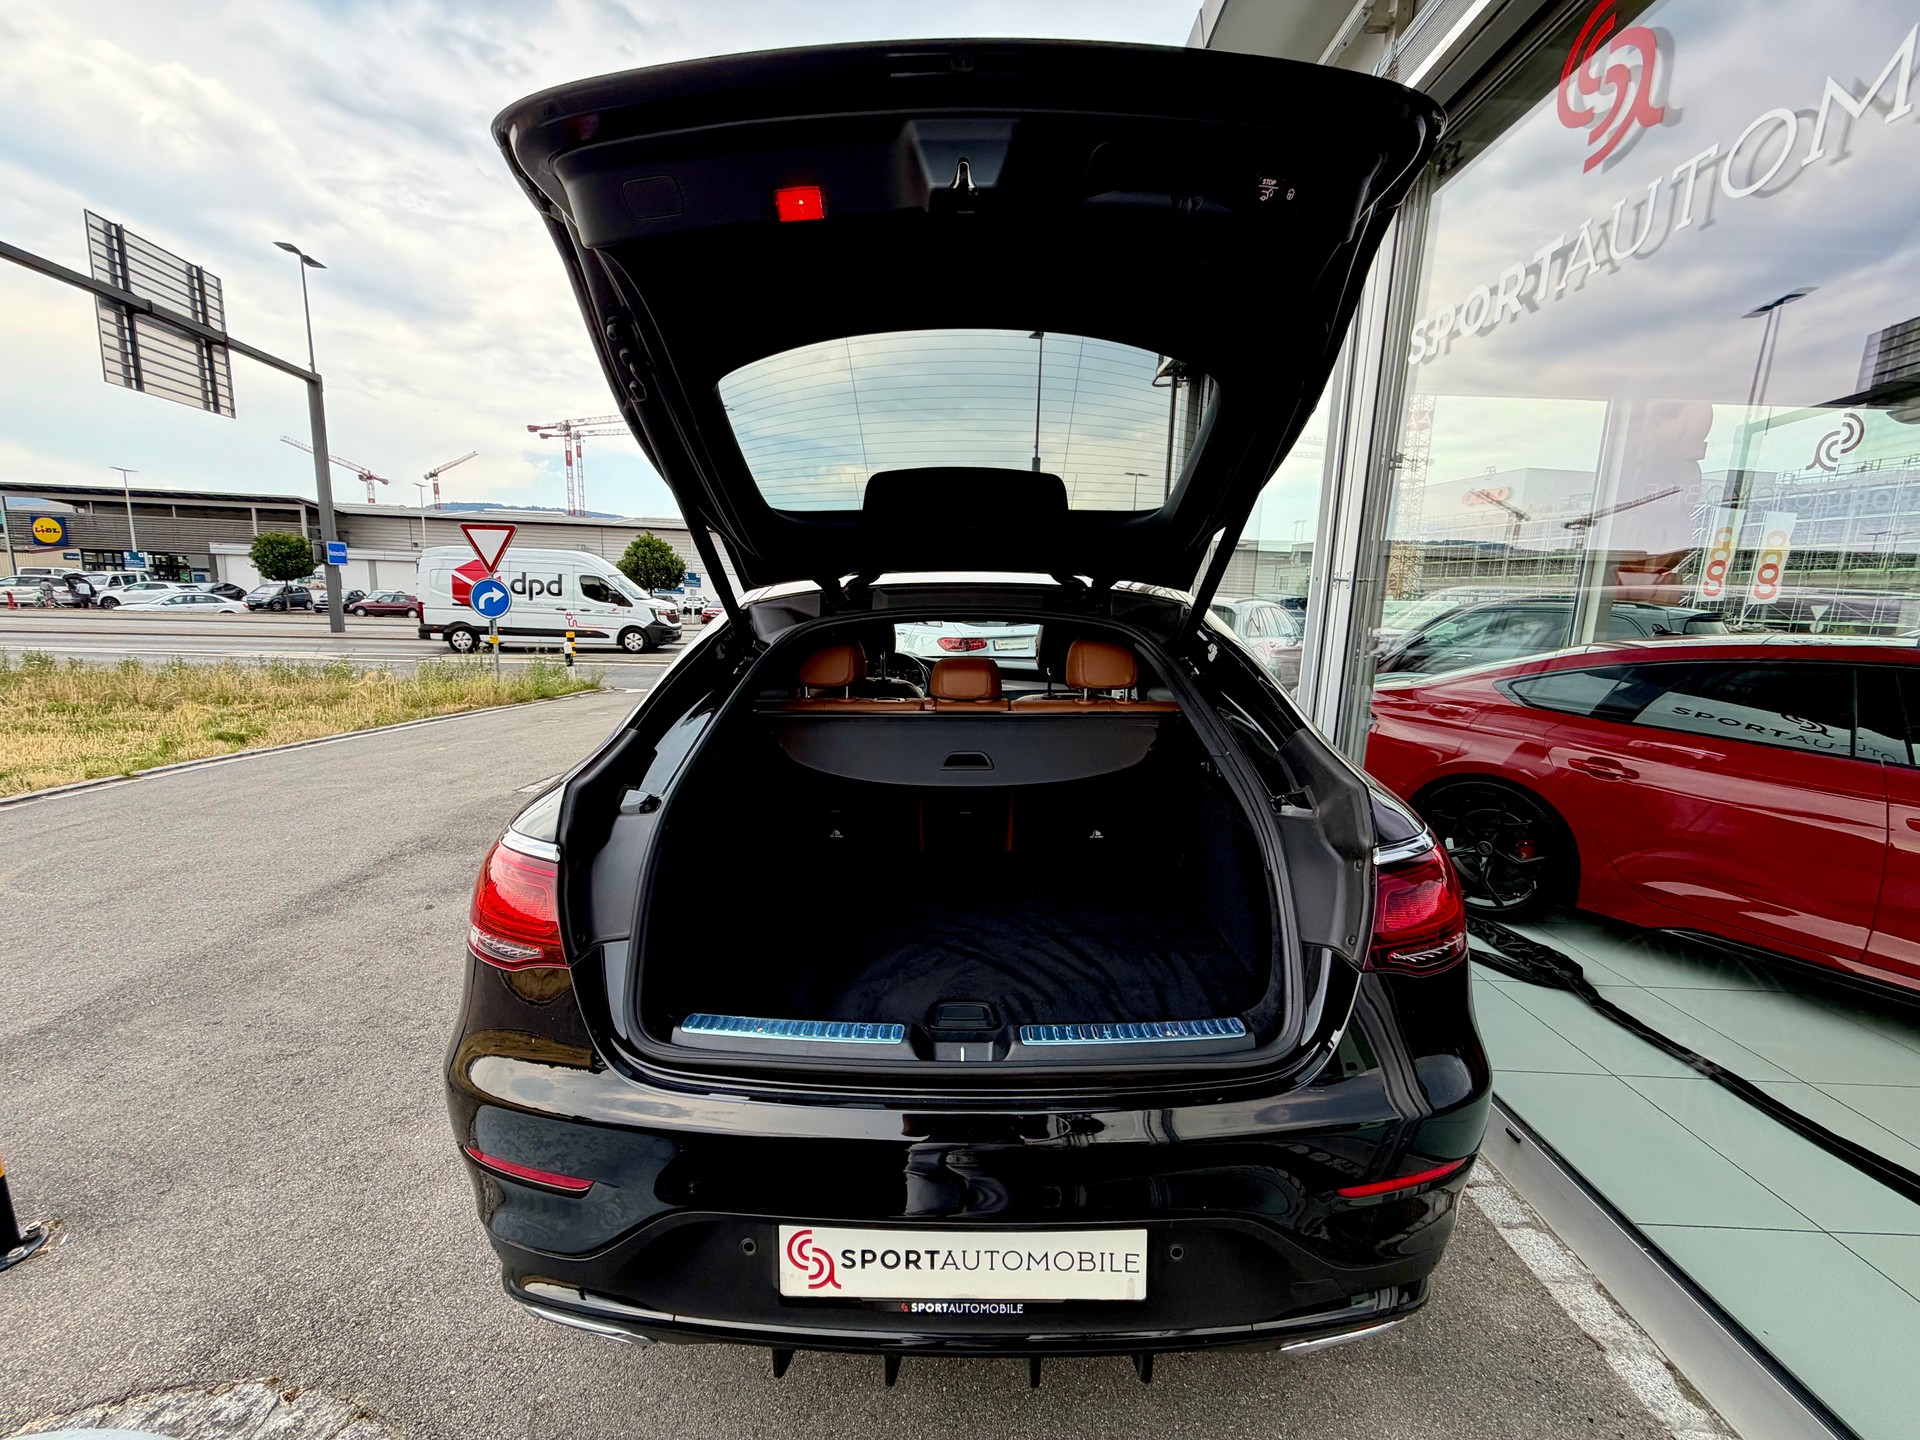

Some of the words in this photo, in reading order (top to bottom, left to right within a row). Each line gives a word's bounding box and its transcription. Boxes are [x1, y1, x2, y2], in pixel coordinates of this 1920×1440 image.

[1262, 178, 1277, 186] STOP
[510, 571, 563, 601] dpd
[841, 1249, 1140, 1273] SPORTAUTOMOBILE
[911, 1303, 1024, 1314] SPORTAUTOMOBILE
